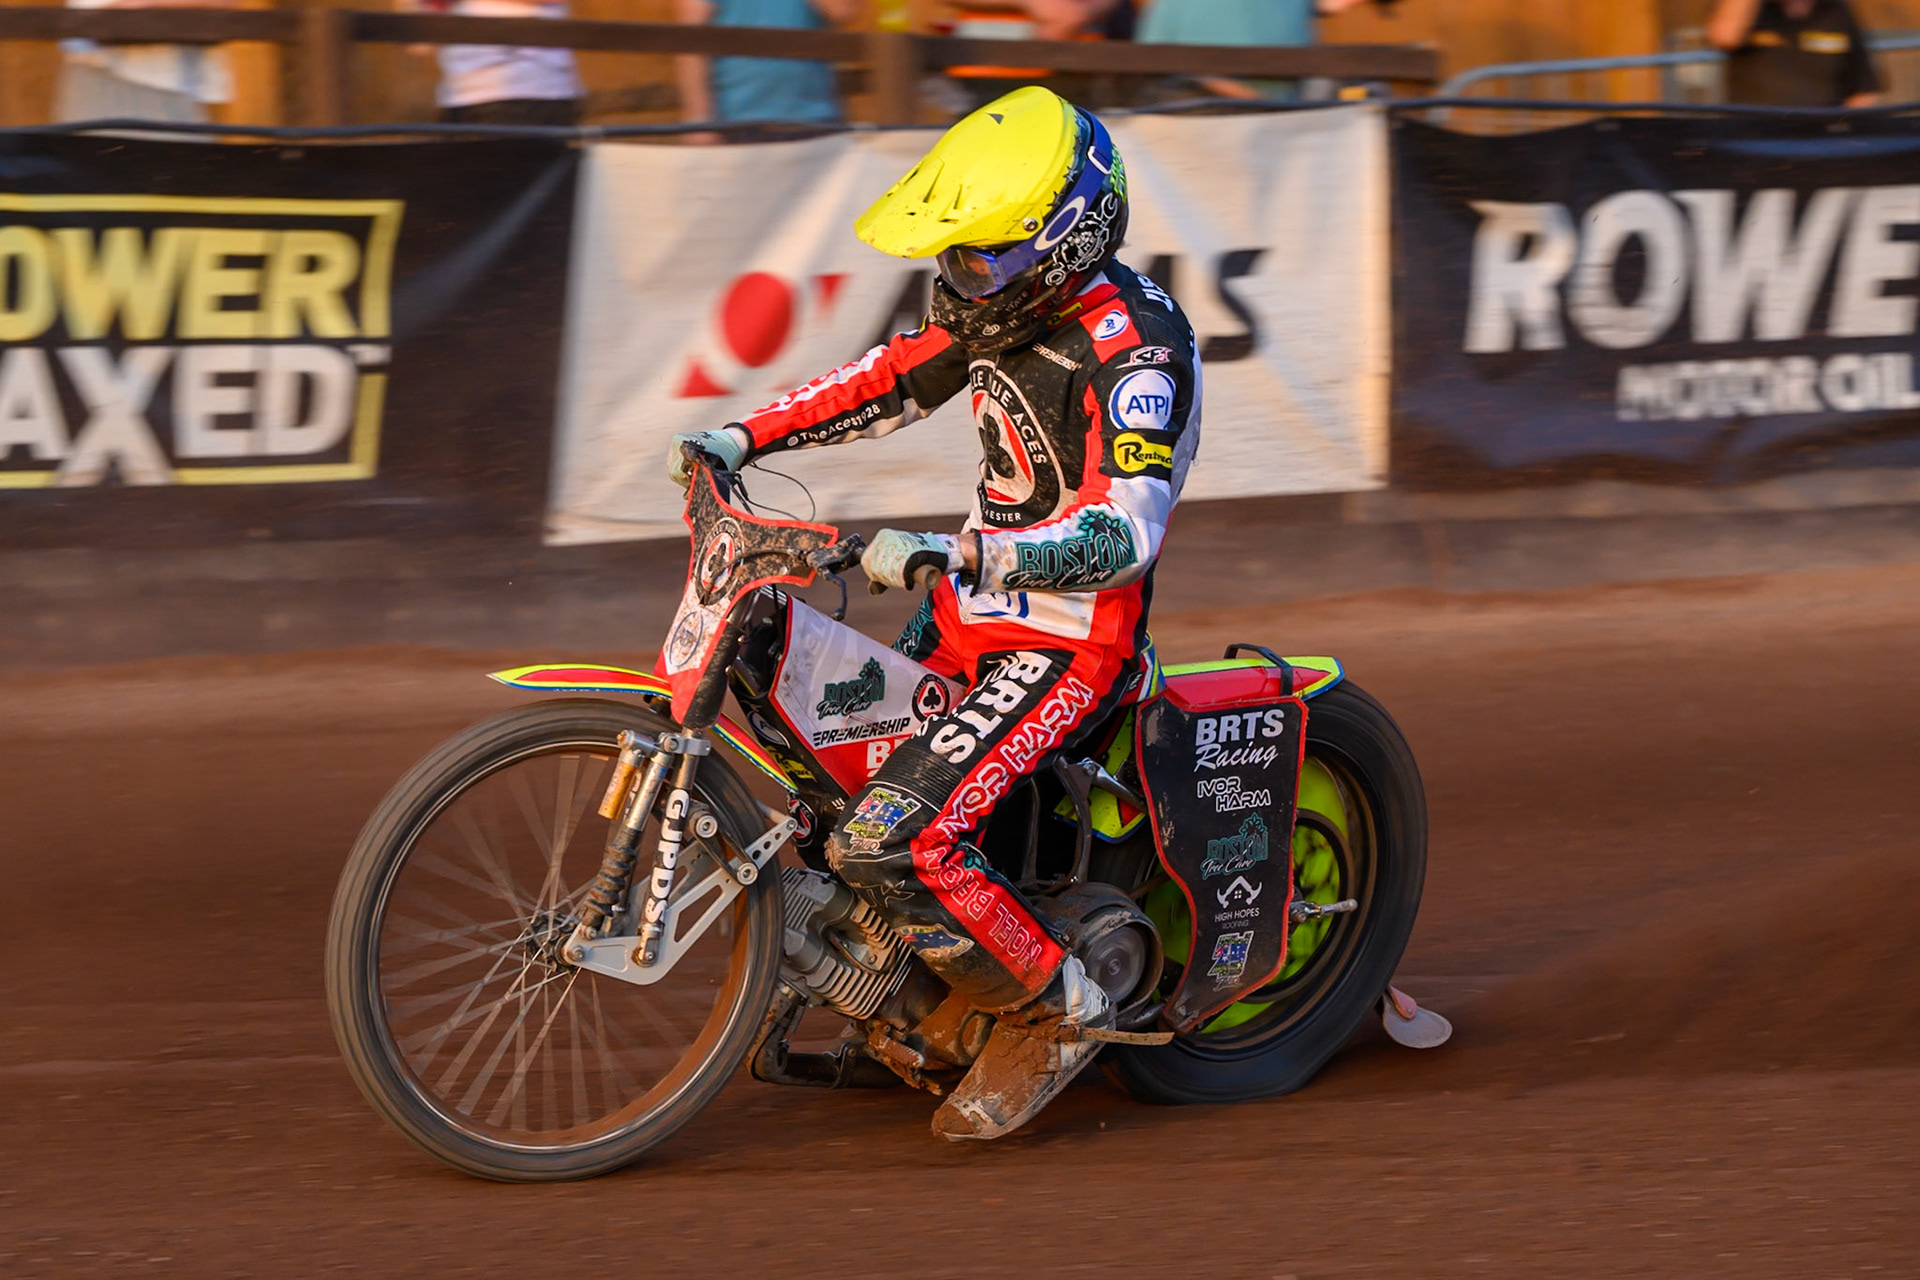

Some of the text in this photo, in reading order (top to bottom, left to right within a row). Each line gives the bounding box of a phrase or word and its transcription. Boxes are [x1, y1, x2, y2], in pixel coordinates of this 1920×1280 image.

[1463, 185, 1920, 353] ROWE
[1616, 353, 1920, 422] MOTOR OIL
[1125, 394, 1170, 417] ATPI
[1012, 412, 1048, 464] ACES
[1016, 524, 1138, 580] BOSTON
[1004, 564, 1113, 589] Tree Care
[823, 672, 886, 704] BOSTON
[816, 697, 873, 720] Tree Care
[929, 650, 1053, 765] BRTS
[813, 717, 911, 746] PREMIERSHIP
[1195, 708, 1285, 747] BRTS
[935, 761, 1010, 839] IVOR
[999, 676, 1096, 773] HARM
[1193, 740, 1279, 773] Racing
[1197, 776, 1242, 798] IVOR
[1216, 788, 1272, 812] HARM
[1206, 831, 1269, 862] BOSTON
[1201, 854, 1254, 876] Tree Care
[1214, 907, 1260, 923] HIGH HOPES
[1222, 920, 1249, 930] ROOFING
[988, 902, 1043, 972] NOEL
